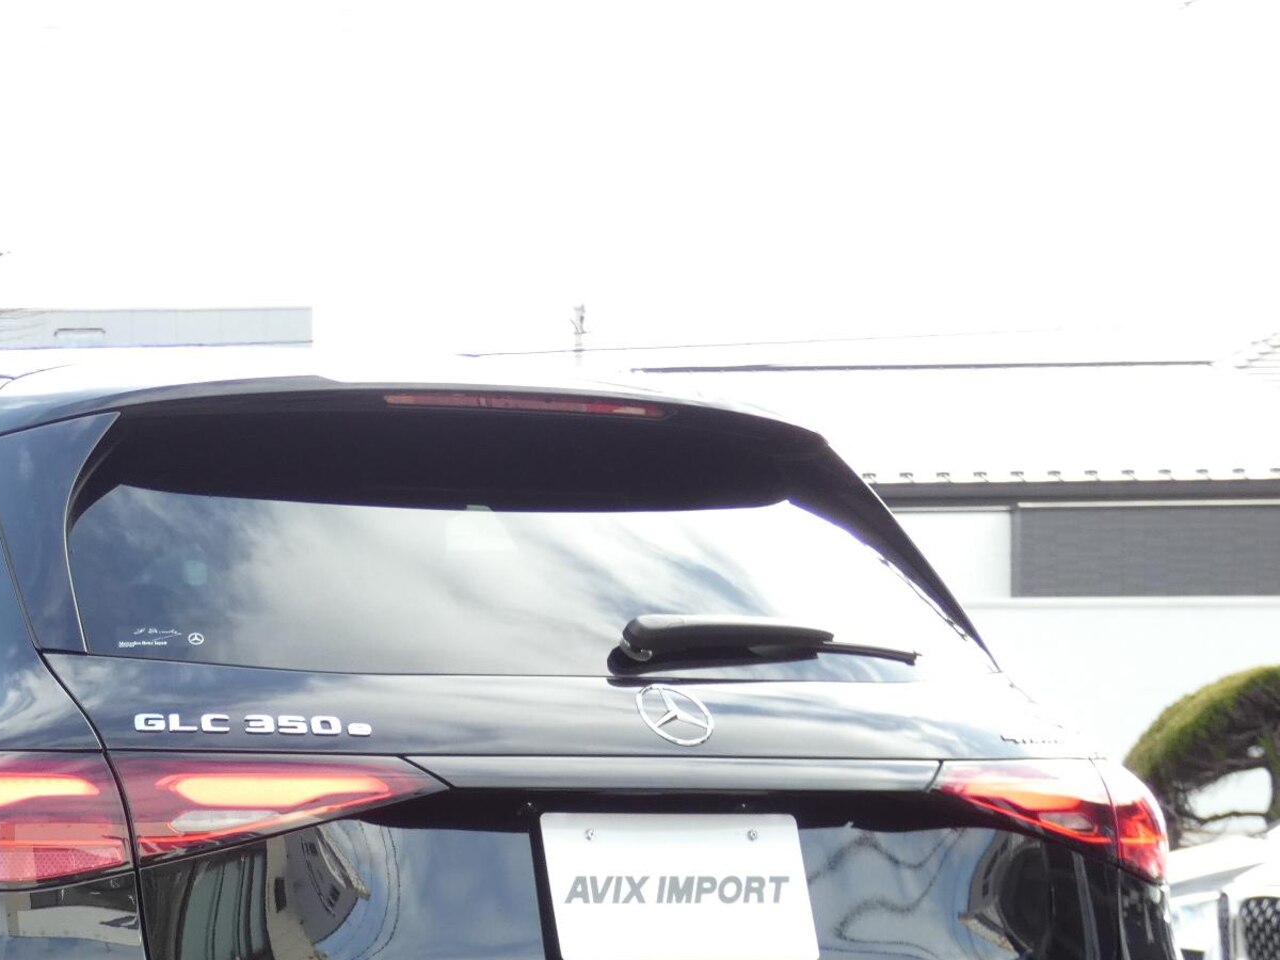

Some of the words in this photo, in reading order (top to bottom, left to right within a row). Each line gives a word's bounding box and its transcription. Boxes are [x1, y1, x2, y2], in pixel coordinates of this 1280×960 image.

[134, 713, 231, 733] GLC
[564, 876, 650, 904] AVIX
[656, 876, 790, 904] IMPORT
